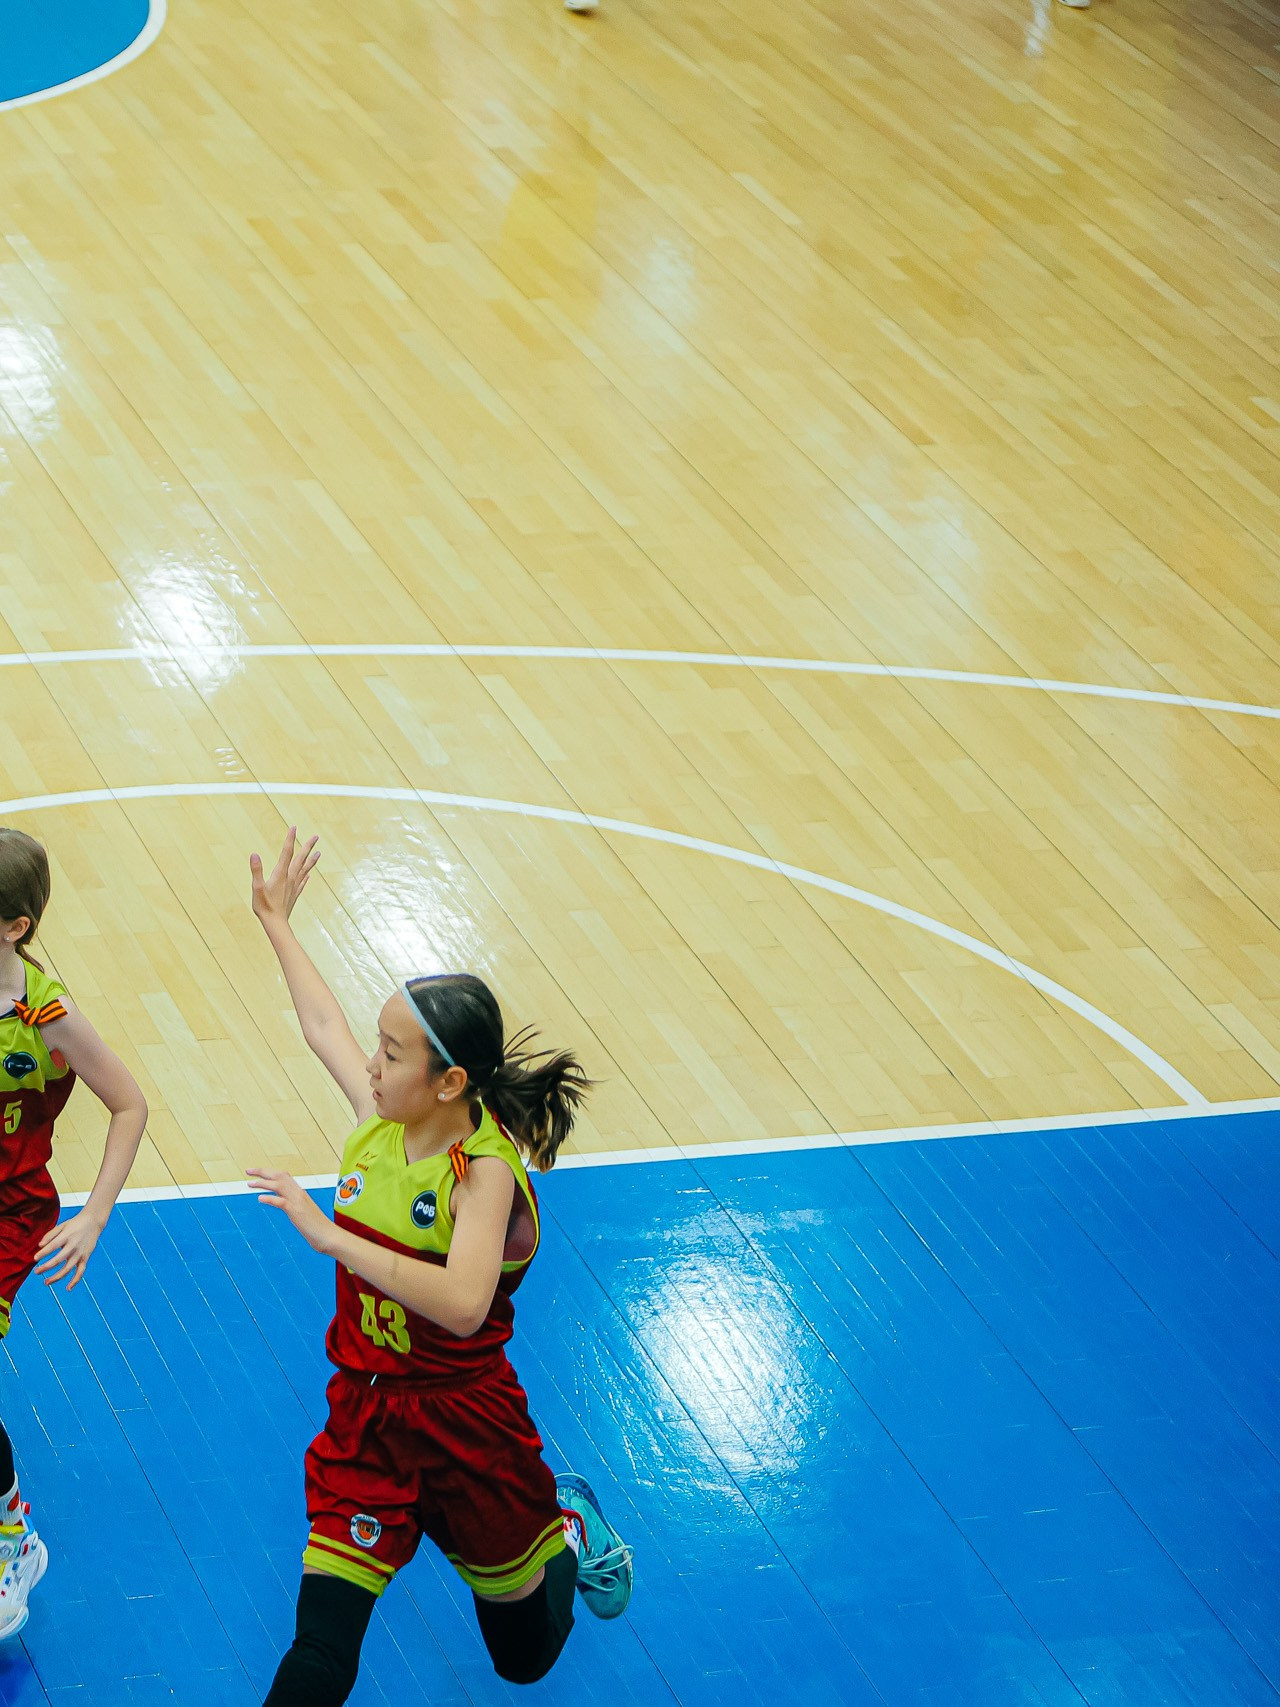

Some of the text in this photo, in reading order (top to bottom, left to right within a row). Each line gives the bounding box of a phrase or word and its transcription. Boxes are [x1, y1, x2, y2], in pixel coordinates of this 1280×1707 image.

[4, 1100, 22, 1134] 5
[415, 1201, 436, 1217] РФБ
[359, 1293, 411, 1354] 43
